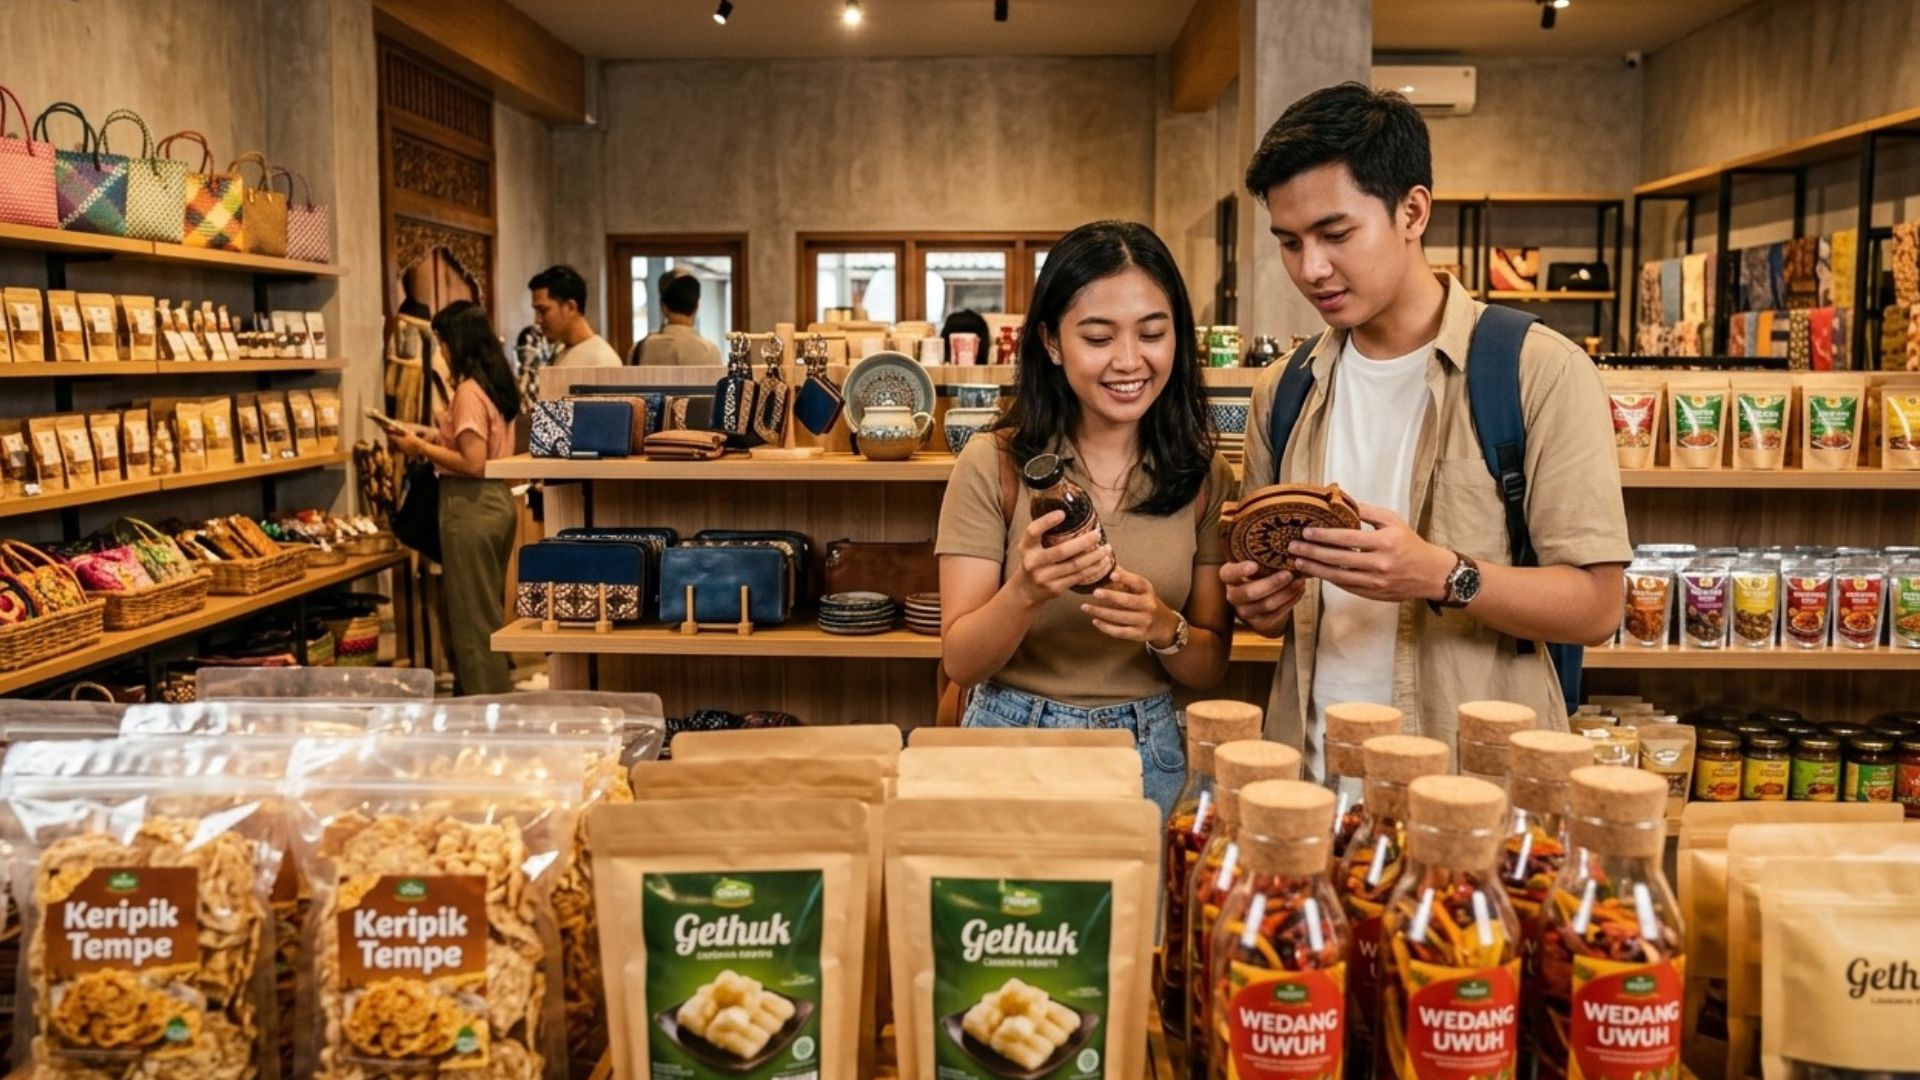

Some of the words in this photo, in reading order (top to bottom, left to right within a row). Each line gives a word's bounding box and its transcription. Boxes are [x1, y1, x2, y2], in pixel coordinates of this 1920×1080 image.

[63, 897, 179, 936] Keripik
[353, 905, 469, 944] Keripik
[65, 932, 173, 966] Tempe
[673, 911, 792, 956] Gethuk
[960, 918, 1079, 962] Gethuk
[356, 940, 463, 975] Tempe
[1239, 1006, 1338, 1034] WEDANG
[1418, 1004, 1515, 1031] WEDANG
[1582, 1000, 1680, 1026] WEDANG
[1251, 1032, 1326, 1056] UWUH
[1432, 1029, 1505, 1053] UWUH
[1597, 1025, 1670, 1047] UWUH
